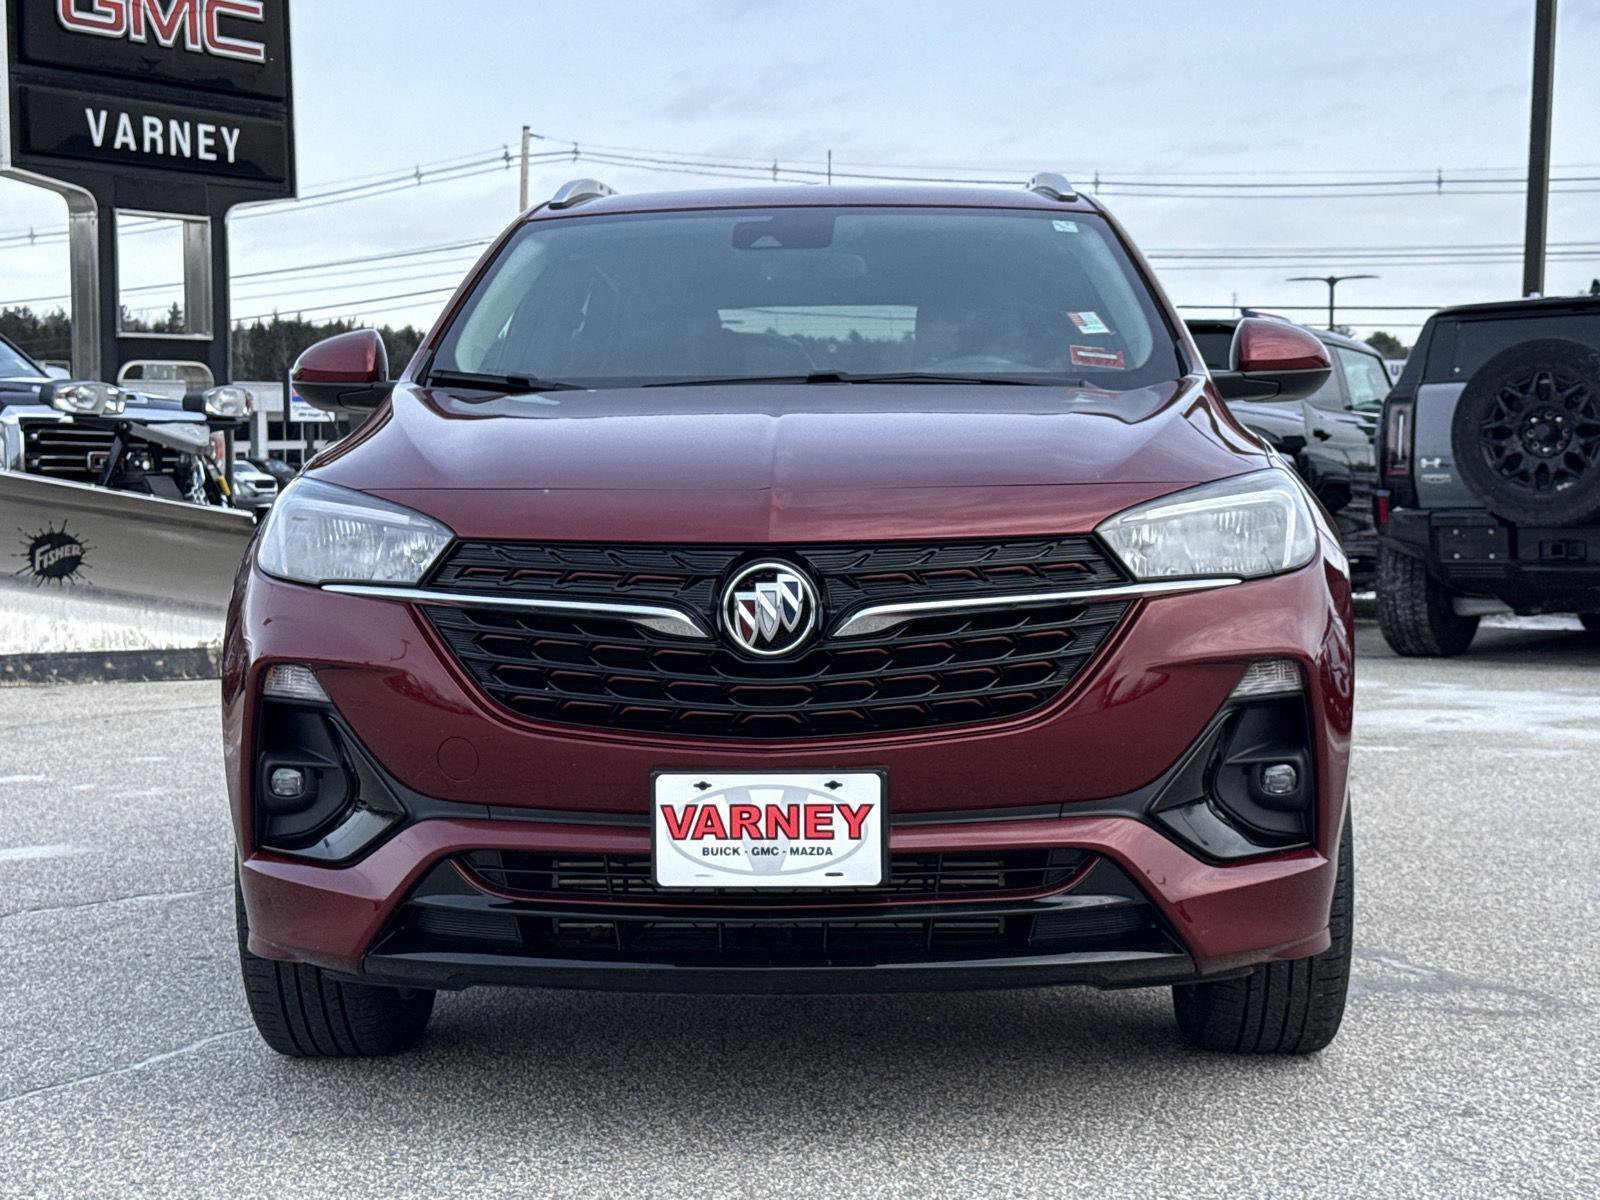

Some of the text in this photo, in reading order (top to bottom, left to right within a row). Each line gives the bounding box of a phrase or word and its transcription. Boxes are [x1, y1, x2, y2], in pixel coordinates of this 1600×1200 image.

[57, 0, 265, 63] GMC
[85, 108, 240, 163] VARNEY
[661, 804, 875, 840] VARNEY
[702, 847, 740, 857] BUICK
[751, 847, 780, 857] GMC
[789, 846, 833, 856] MAZDA
